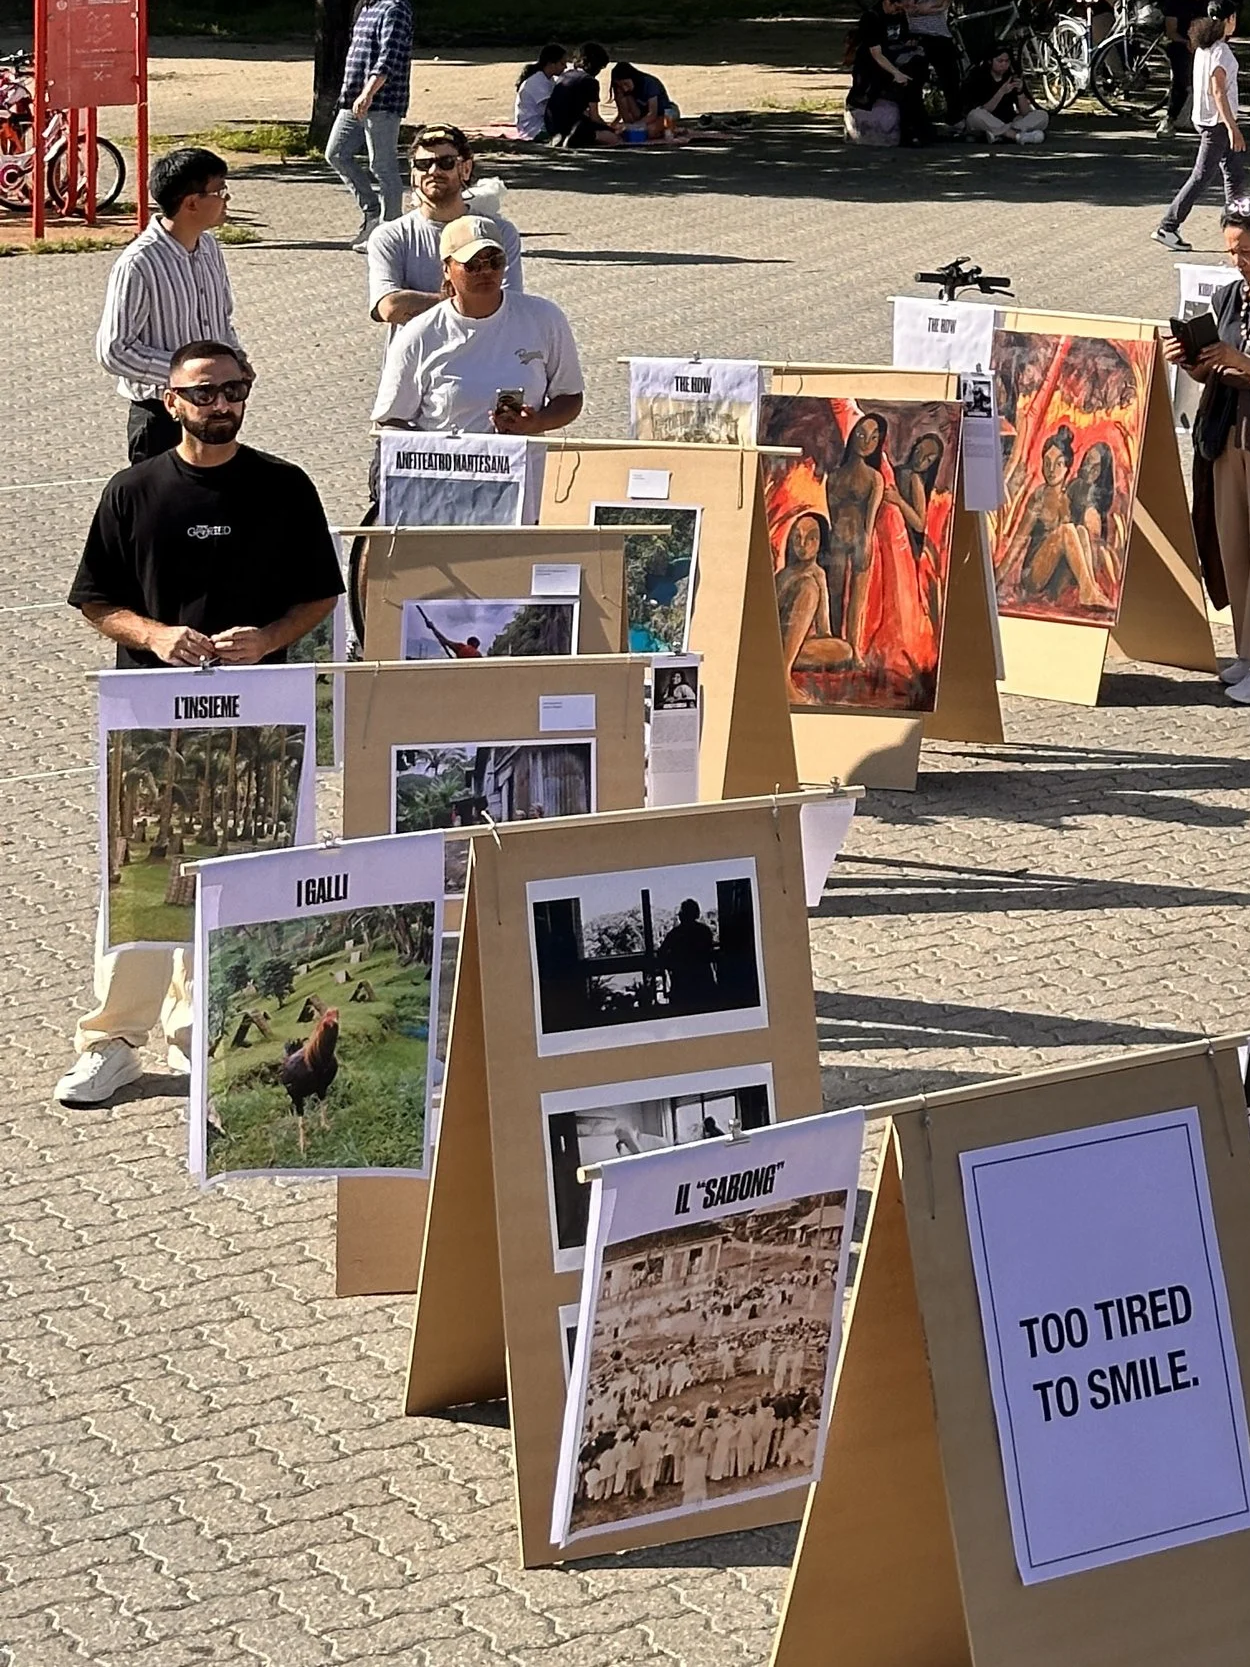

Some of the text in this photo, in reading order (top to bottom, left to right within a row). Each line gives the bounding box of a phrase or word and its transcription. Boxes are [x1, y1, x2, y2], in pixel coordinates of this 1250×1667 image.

[674, 376, 690, 392] THE
[396, 451, 510, 474] ANFITEATRO MARTESANA
[174, 695, 240, 720] L'INSIEME
[297, 873, 349, 907] I GALLI
[675, 1183, 691, 1215] IL
[1019, 1285, 1192, 1358] TOO TIRED
[1032, 1349, 1200, 1422] TO SMILE.
